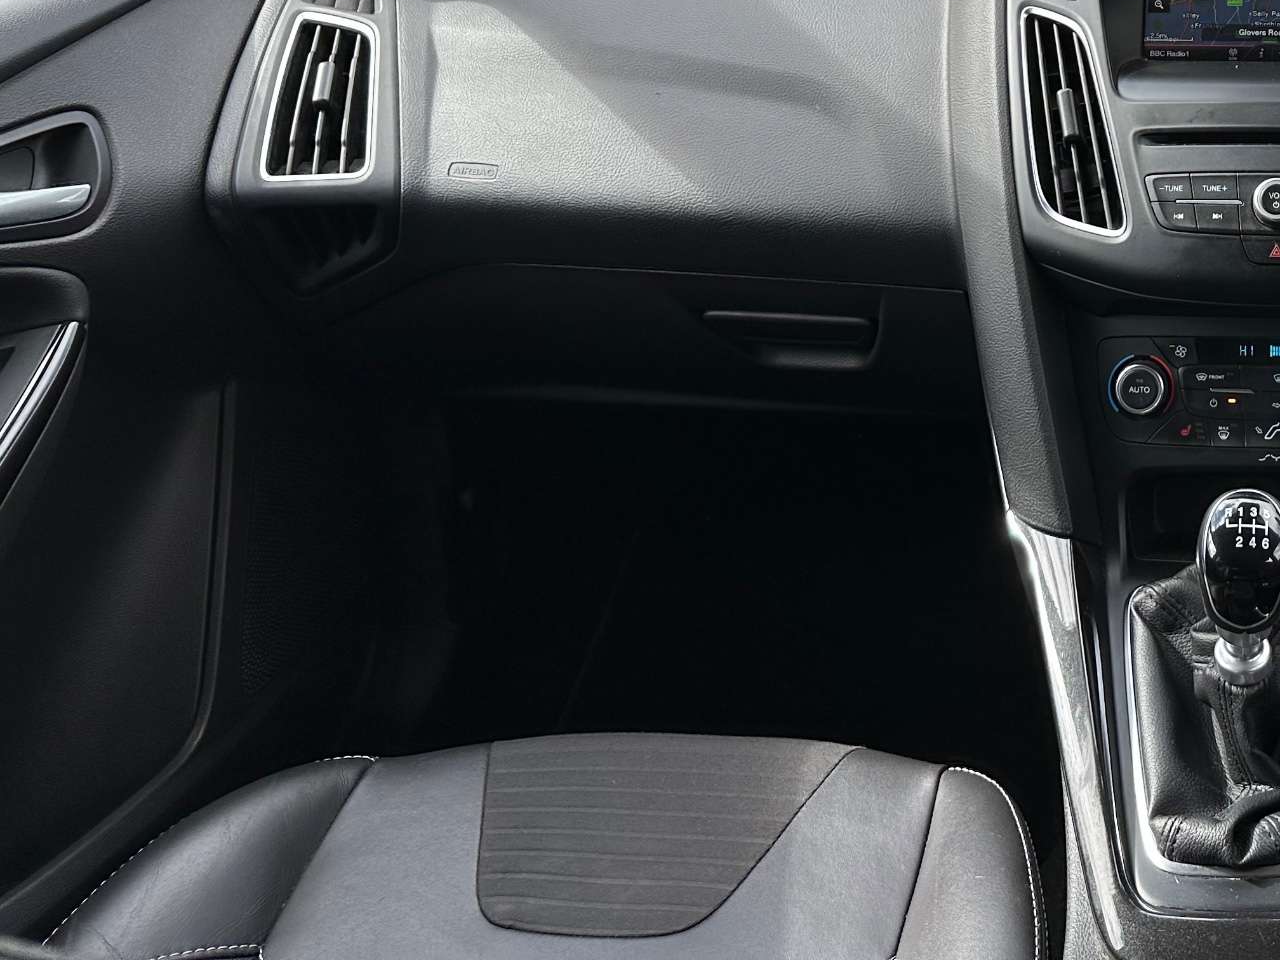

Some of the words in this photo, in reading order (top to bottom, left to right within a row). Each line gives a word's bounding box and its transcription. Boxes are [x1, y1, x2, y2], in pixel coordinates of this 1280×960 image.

[1238, 28, 1266, 37] Glovers
[453, 167, 495, 177] AIRBAG
[1128, 386, 1151, 394] AUTO
[1249, 506, 1258, 517] 3
[1235, 535, 1244, 548] 2
[1248, 536, 1257, 549] 4
[1261, 537, 1270, 550] 6
